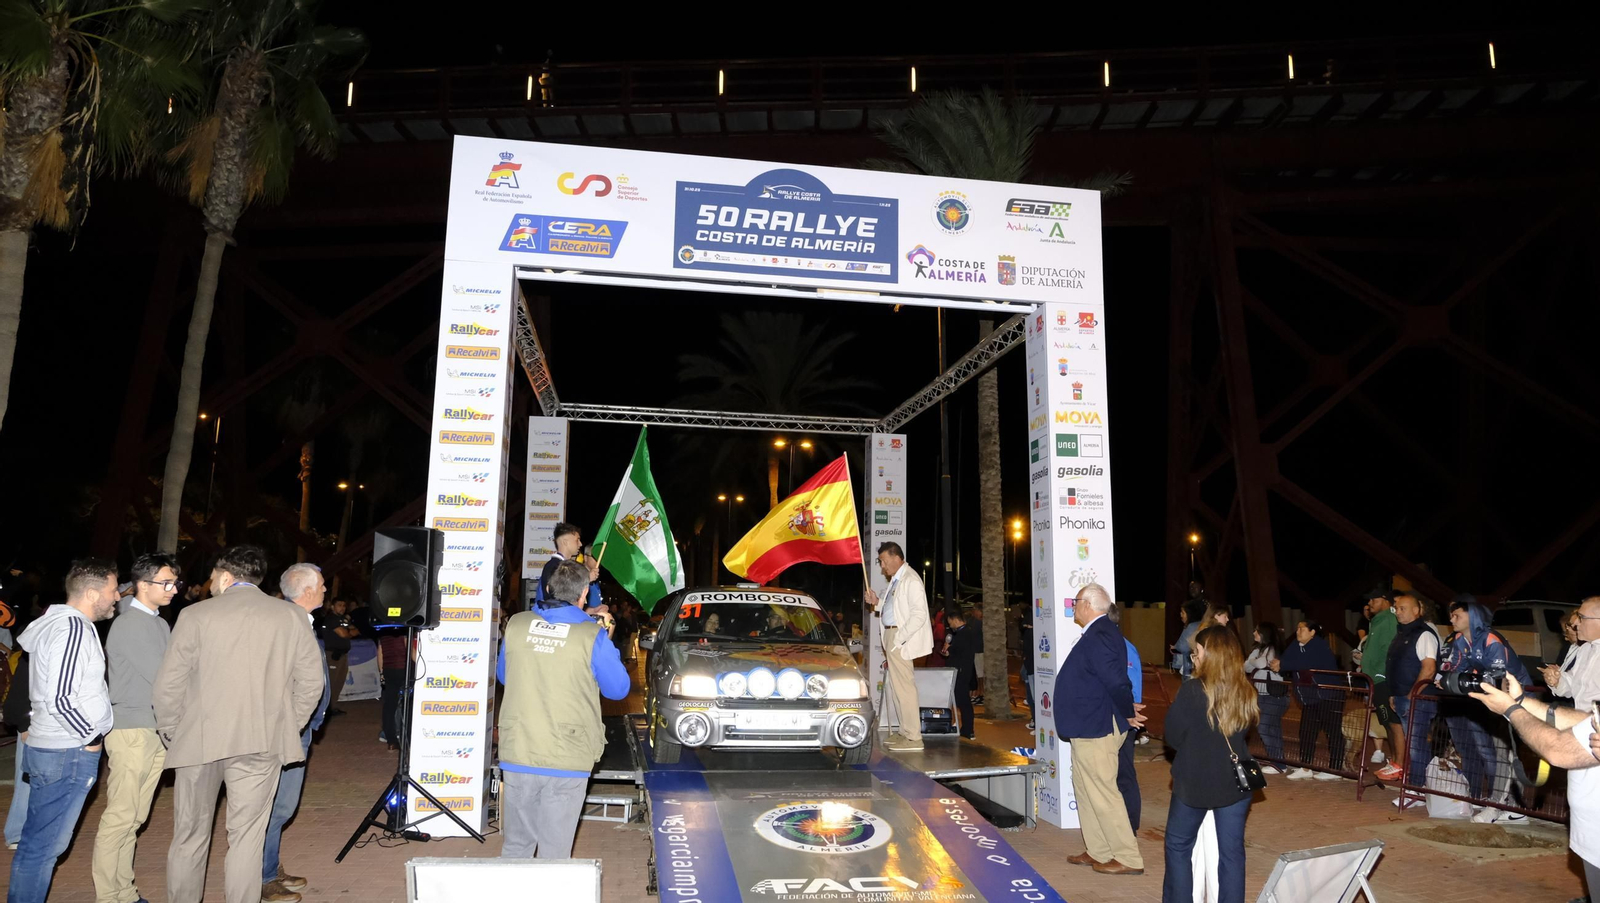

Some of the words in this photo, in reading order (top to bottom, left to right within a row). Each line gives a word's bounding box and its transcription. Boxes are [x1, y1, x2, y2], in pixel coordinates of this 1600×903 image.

[696, 204, 740, 227] 50
[742, 208, 878, 238] RALLYE
[548, 221, 612, 236] CERA
[560, 241, 599, 252] Recalvi
[696, 230, 757, 245] COSTA
[762, 235, 787, 247] DE
[790, 237, 876, 254] ALMERÍA
[938, 258, 970, 269] COSTA
[973, 262, 986, 270] DE
[928, 270, 987, 284] ALMERÍA
[1021, 266, 1086, 279] DIPUTACIÓN
[1021, 277, 1035, 286] DE
[1038, 276, 1083, 289] ALMERÍA
[457, 348, 489, 357] Recalvi
[450, 433, 484, 442] Recalvi
[1057, 465, 1103, 478] gasolia
[443, 519, 477, 529] Recalvi
[1060, 516, 1105, 529] Phonika
[440, 584, 482, 596] allycar
[700, 593, 809, 605] ROMBOSOL
[678, 603, 702, 618] 31
[526, 636, 566, 647] FOTO/TV
[533, 644, 555, 654] 2025
[432, 704, 468, 712] Recalvi
